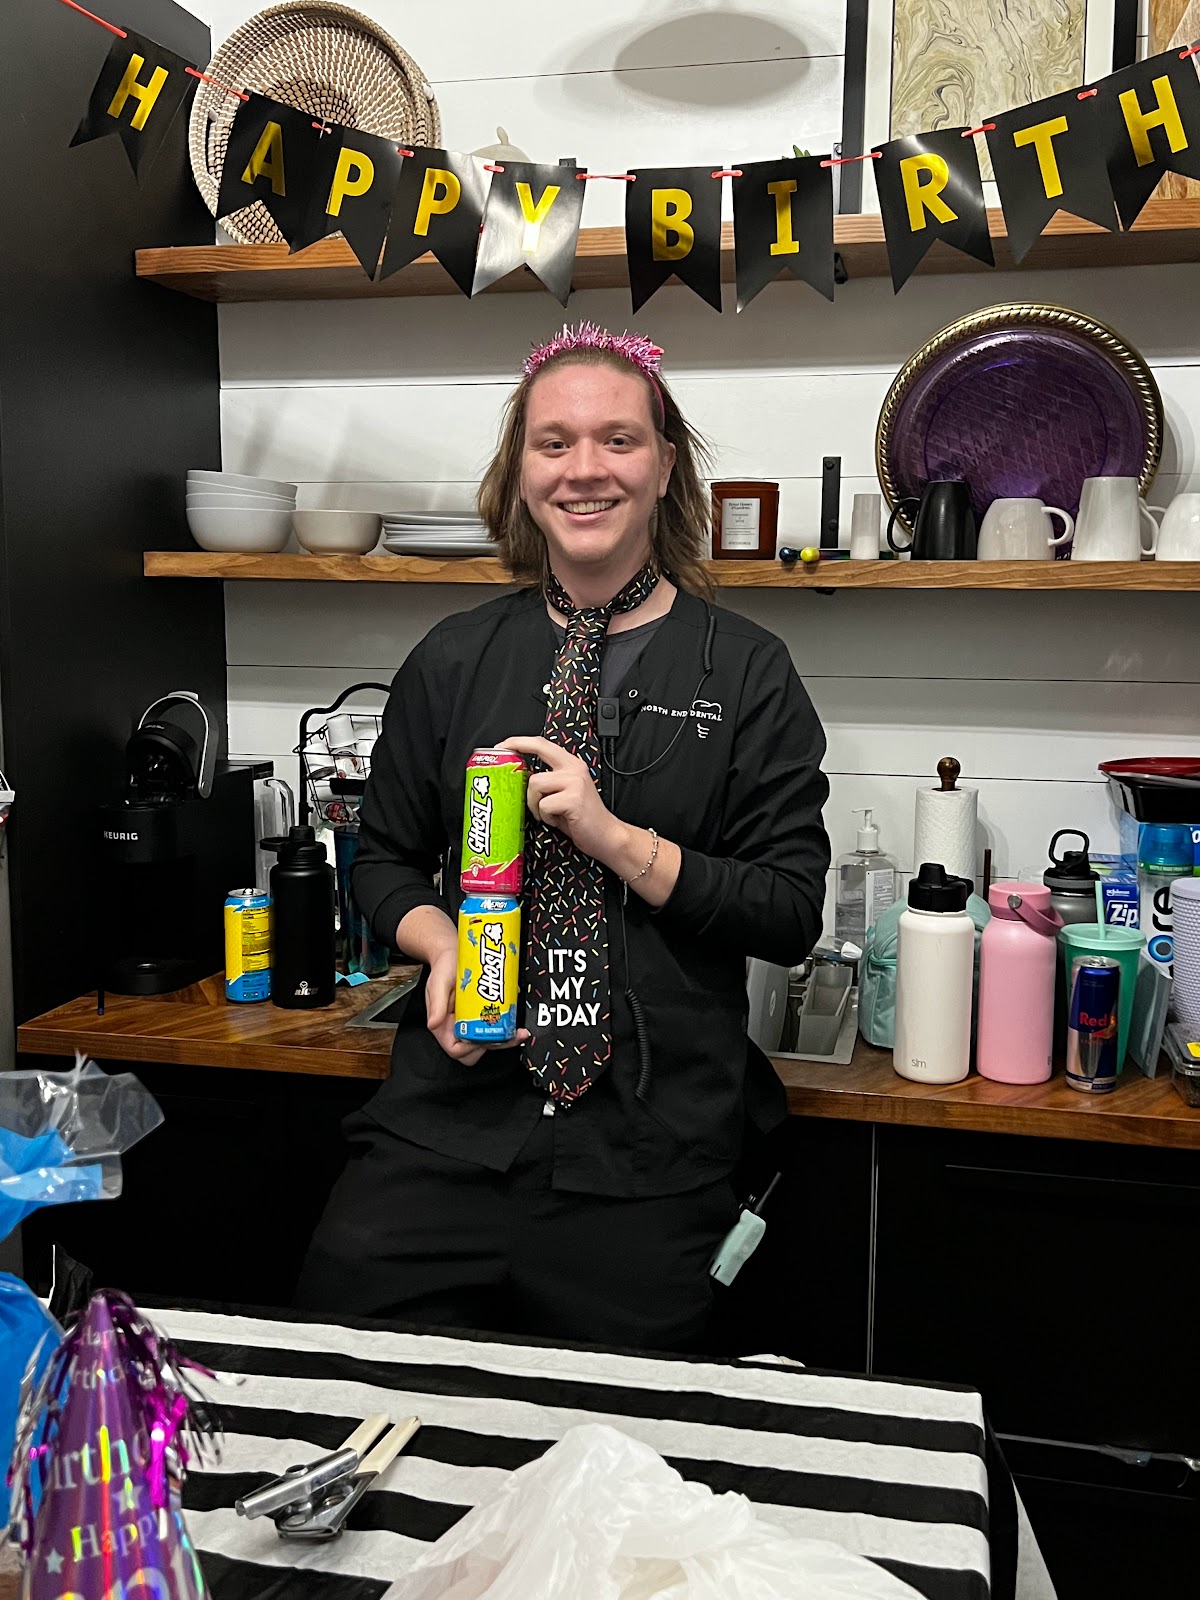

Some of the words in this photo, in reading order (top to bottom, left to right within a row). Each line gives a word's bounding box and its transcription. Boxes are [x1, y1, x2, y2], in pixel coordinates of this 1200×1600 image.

[107, 53, 561, 253] HAPPY
[651, 74, 1189, 262] BIRTH
[641, 705, 668, 716] NORTH
[670, 709, 688, 718] END
[689, 710, 722, 722] DENTAL
[103, 830, 139, 841] KEURIG
[467, 791, 492, 856] GHOST
[476, 934, 506, 1003] GHOST
[548, 949, 587, 973] IT'S
[550, 977, 586, 1000] MY
[537, 1003, 601, 1027] B-DAY
[1080, 1012, 1107, 1027] Red
